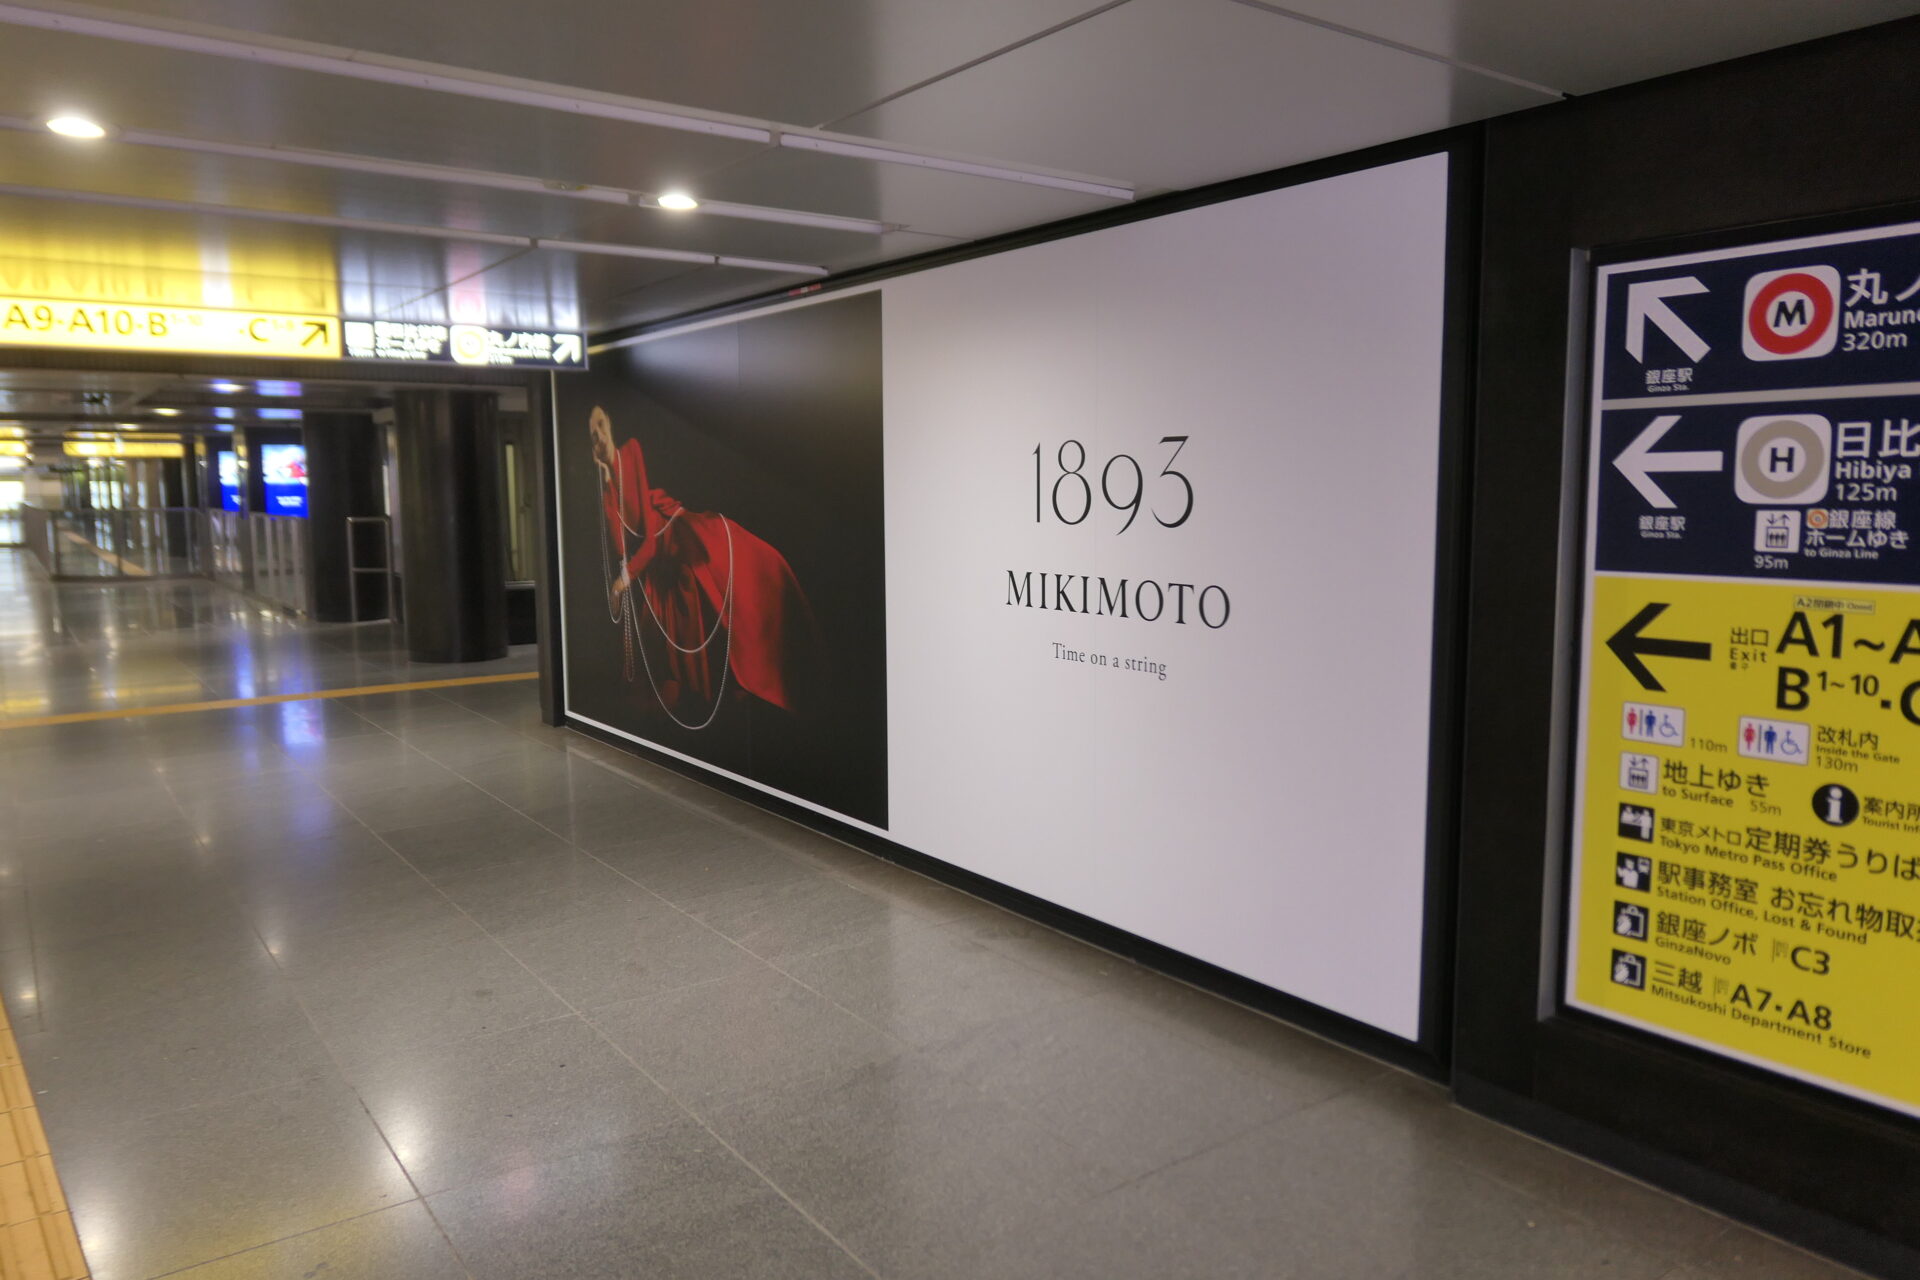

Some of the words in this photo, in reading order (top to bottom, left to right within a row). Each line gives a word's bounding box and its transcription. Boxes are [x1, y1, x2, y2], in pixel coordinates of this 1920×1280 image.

[1773, 299, 1807, 328] M
[1842, 331, 1908, 351] 320m
[1645, 368, 1693, 384] 銀座駅
[1836, 419, 1920, 458] 日比
[1769, 447, 1796, 473] H
[1834, 461, 1912, 483] Hibiya
[1032, 436, 1194, 536] 1893
[1835, 483, 1898, 502] 125m
[1639, 515, 1686, 530] 銀座駅
[1829, 509, 1897, 529] 銀座線
[1805, 529, 1909, 549] ホームゆき
[1754, 555, 1789, 569] 95m
[1804, 547, 1817, 557] to
[1819, 547, 1852, 558] Ginza
[1854, 549, 1879, 559] Line
[1006, 570, 1231, 629] MIKIMOTO
[1730, 626, 1769, 647] 出口
[1053, 642, 1085, 662] Time
[1091, 651, 1107, 666] on
[1113, 656, 1120, 668] a
[1125, 657, 1167, 681] string
[1730, 647, 1768, 663] Exit
[1690, 738, 1728, 753] 110m
[1817, 725, 1879, 751] 改札内
[1816, 744, 1848, 757] Inside
[1851, 749, 1869, 760] the
[1873, 752, 1900, 764] Gate
[1816, 756, 1859, 773] 130m
[1663, 760, 1769, 797] 地上ゆき
[1662, 785, 1677, 798] to
[1681, 788, 1734, 808] Surface
[1750, 800, 1782, 817] 55m
[1863, 816, 1900, 831] Tourist
[1660, 836, 1701, 857] Tokyo
[1705, 845, 1748, 864] Metro
[1754, 856, 1785, 872] Pass
[1791, 863, 1838, 882] Office
[1659, 860, 1758, 906] 駅事務室
[1770, 885, 1920, 941] お忘れ物取
[1657, 886, 1706, 907] Station
[1710, 897, 1757, 920] Office,
[1764, 911, 1796, 930] Lost
[1800, 919, 1811, 932] &
[1817, 923, 1868, 945] Found
[1655, 937, 1731, 966] GinzaNovo
[1657, 911, 1758, 956] 銀座ノボ
[1791, 946, 1830, 975] C3
[1653, 960, 1703, 994] 三越
[1651, 986, 1726, 1015] Mitsukoshi
[1732, 1007, 1822, 1045] Department
[1829, 1036, 1872, 1059] Store
